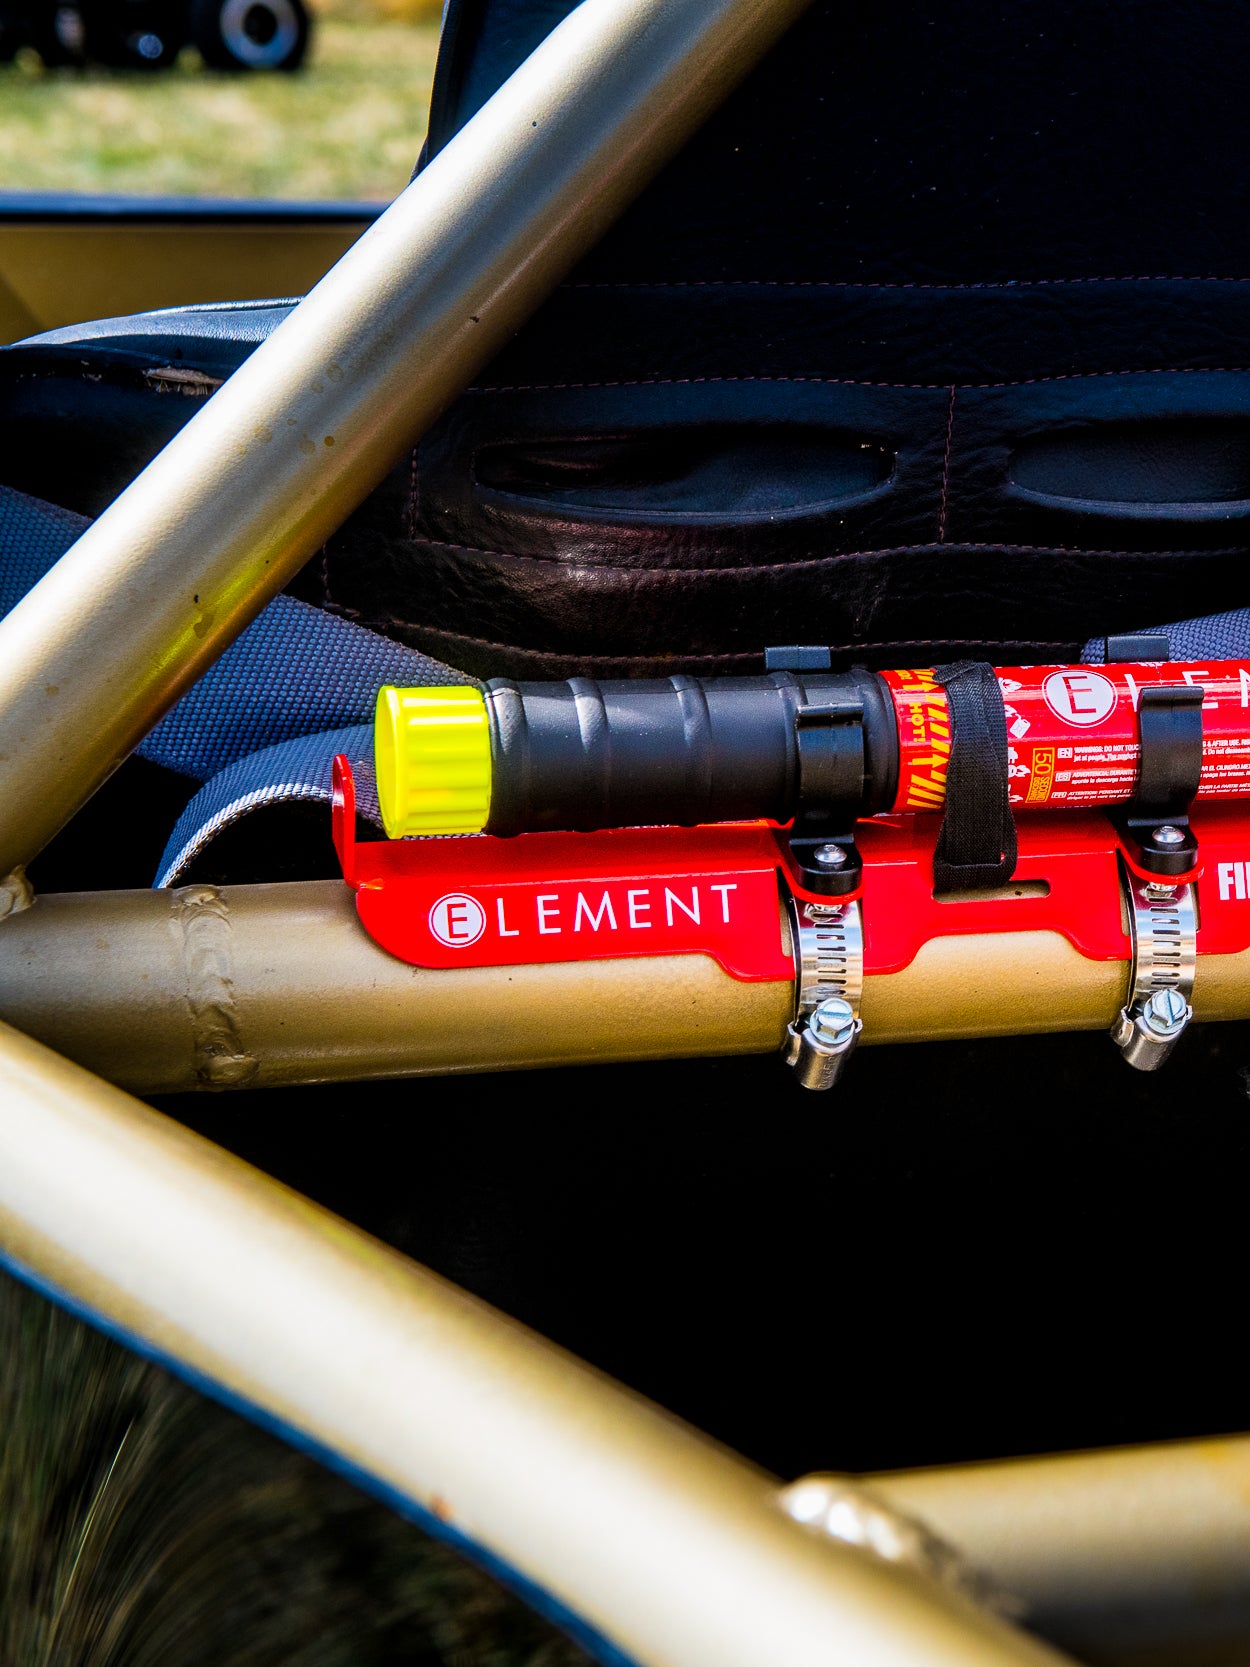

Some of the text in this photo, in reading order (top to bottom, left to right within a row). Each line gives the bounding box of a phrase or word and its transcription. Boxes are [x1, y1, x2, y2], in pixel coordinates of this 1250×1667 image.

[909, 702, 926, 743] HOT!
[1113, 744, 1124, 752] NOT
[1035, 753, 1052, 775] 50
